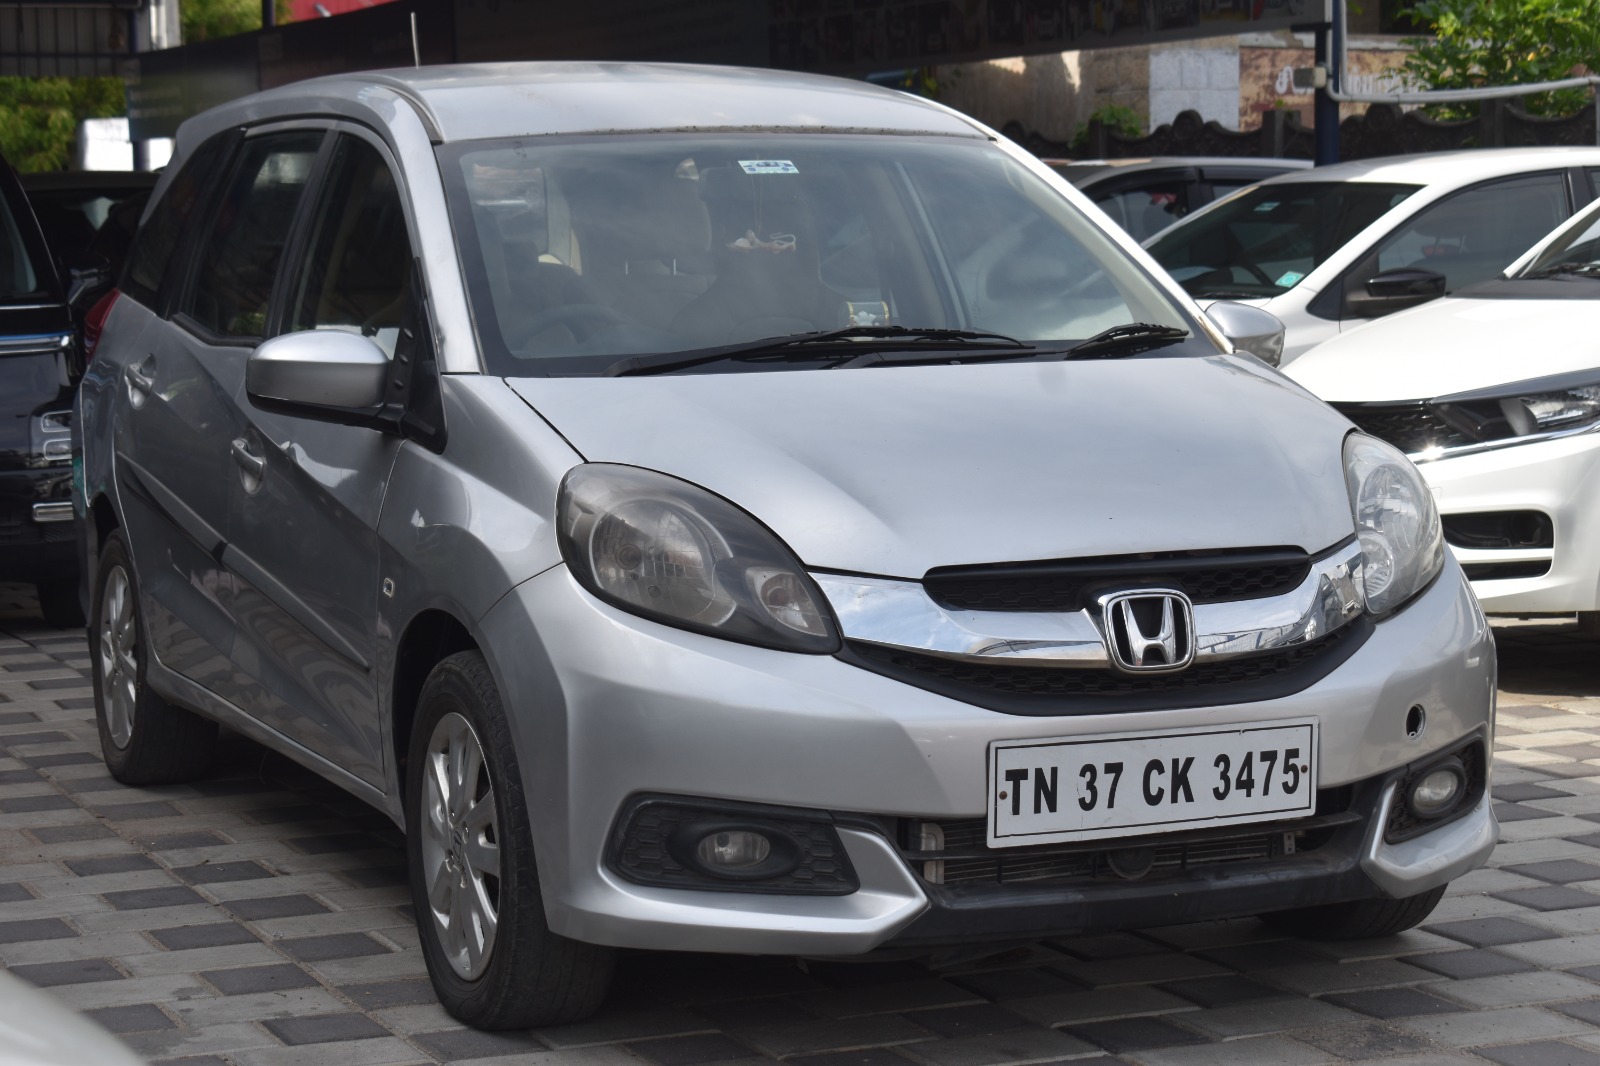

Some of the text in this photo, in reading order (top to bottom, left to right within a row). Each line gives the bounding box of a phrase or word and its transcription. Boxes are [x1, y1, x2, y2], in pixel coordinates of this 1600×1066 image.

[1005, 747, 1301, 816] TN 37 CK 3475
